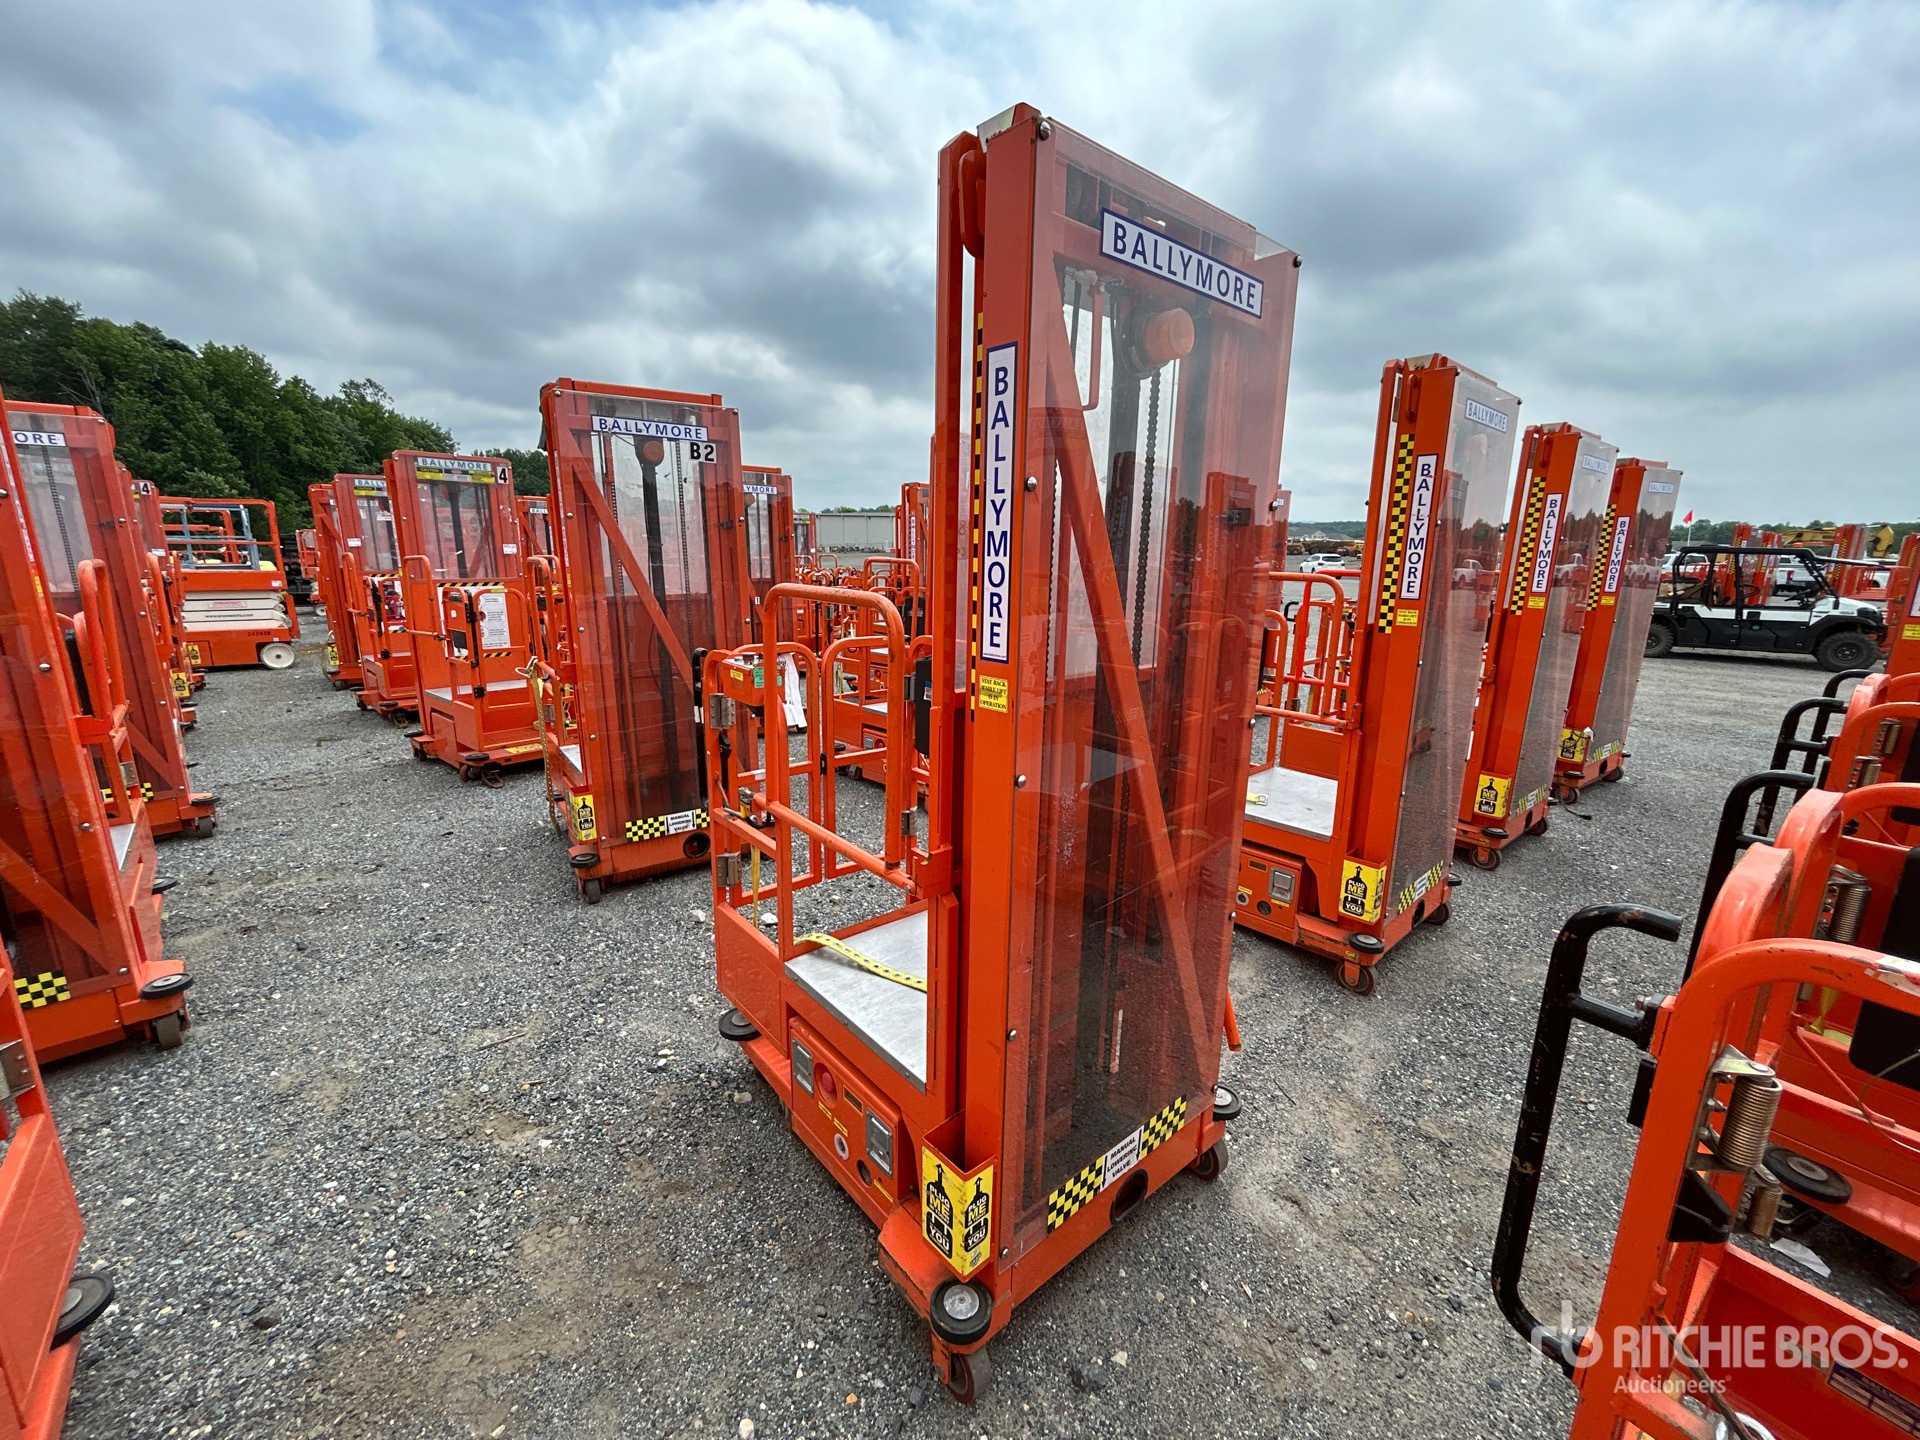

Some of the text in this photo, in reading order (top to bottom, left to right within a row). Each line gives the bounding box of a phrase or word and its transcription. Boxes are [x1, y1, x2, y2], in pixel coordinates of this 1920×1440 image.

[1113, 221, 1256, 310] BALLYMORE
[1469, 401, 1506, 430] BALLYMORE
[598, 418, 703, 439] BALLYMORE
[422, 459, 488, 470] BALLYMORE
[499, 468, 508, 484] 4
[141, 483, 150, 495] 4
[986, 366, 1010, 648] BALLYMORE
[1406, 463, 1432, 594] BALLYMORE
[1536, 499, 1558, 589] BALLYMORE
[1607, 520, 1627, 590] BALLYMORE
[980, 700, 1006, 709] OPERATION
[1347, 885, 1365, 894] ME
[1348, 880, 1365, 889] PLUG
[1345, 903, 1362, 913] YOU
[1107, 1144, 1138, 1173] LOWERING
[1111, 1136, 1136, 1160] MANUAL
[1112, 1160, 1131, 1178] VALVE
[929, 1184, 950, 1206] PLUG
[929, 1193, 950, 1217] ME
[968, 1195, 987, 1212] PLUG
[968, 1203, 987, 1219] ME
[929, 1226, 950, 1251] YOU
[967, 1228, 986, 1246] YOU
